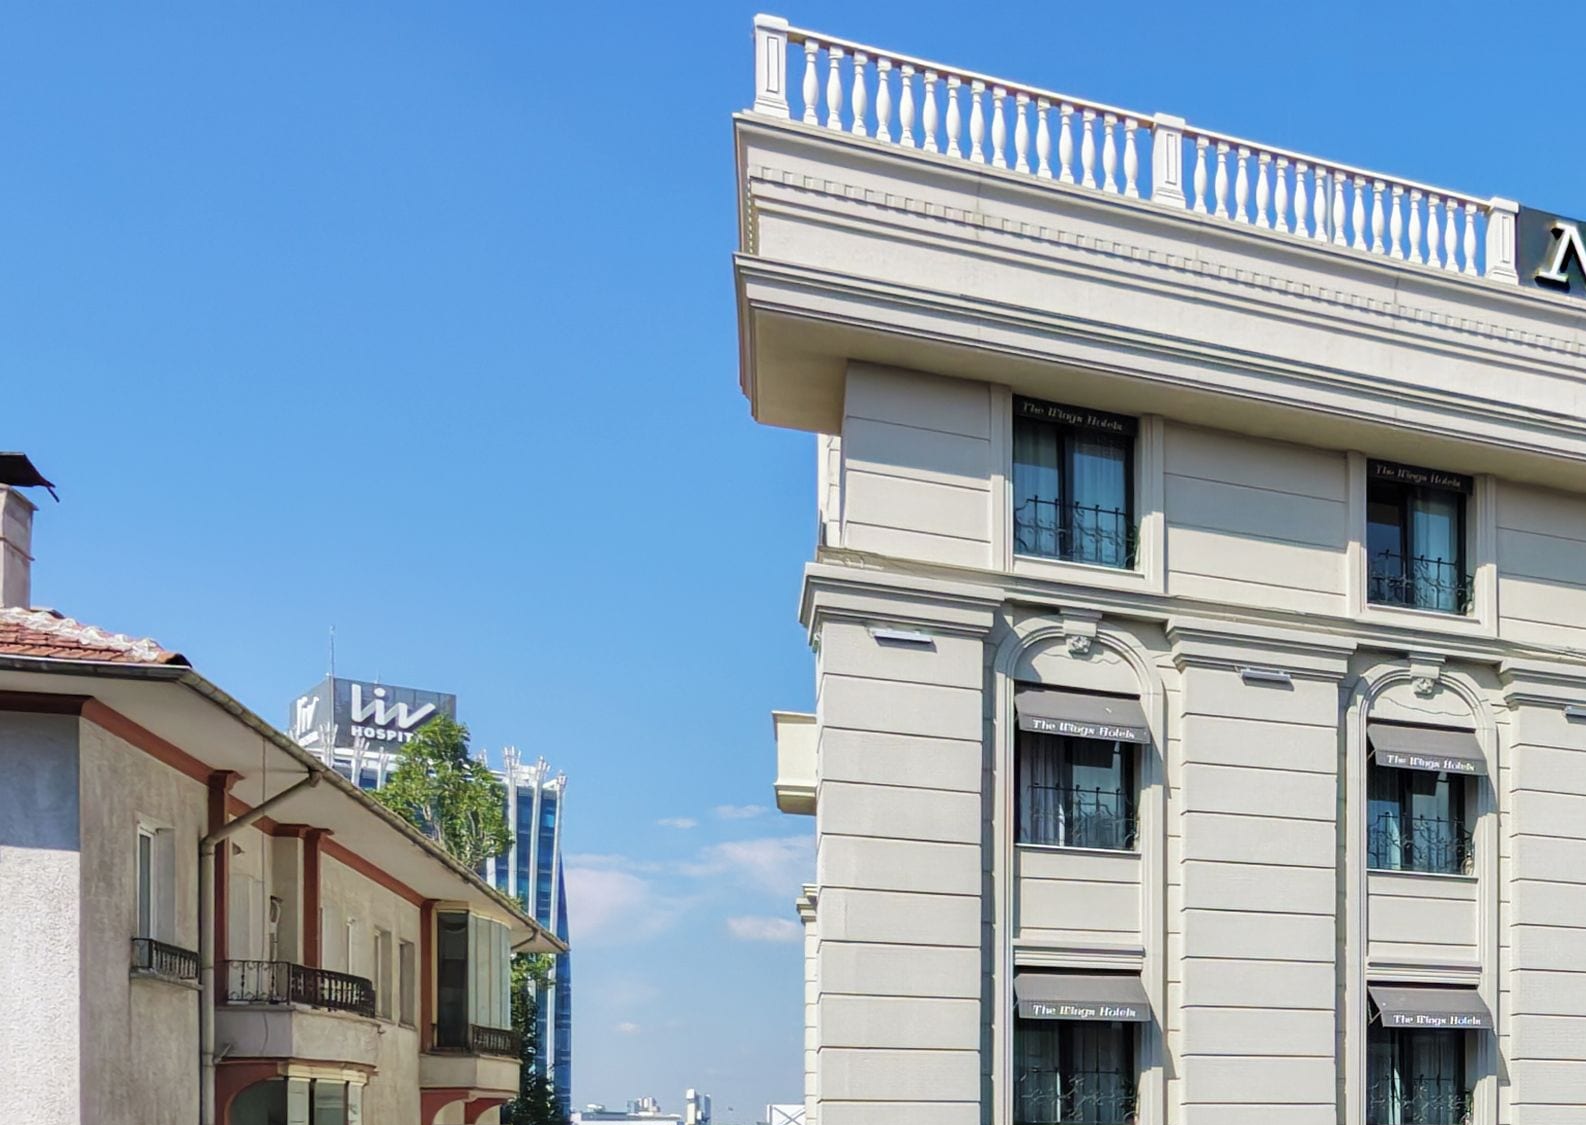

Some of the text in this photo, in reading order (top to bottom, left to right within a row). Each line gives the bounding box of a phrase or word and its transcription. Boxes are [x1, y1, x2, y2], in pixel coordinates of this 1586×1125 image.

[351, 726, 424, 741] HOSPIT
[1032, 719, 1056, 731] The
[1099, 727, 1135, 739] Hotels
[1386, 754, 1407, 765] The
[1032, 1004, 1136, 1018] The Wings Hotels
[1392, 1014, 1414, 1025] The
